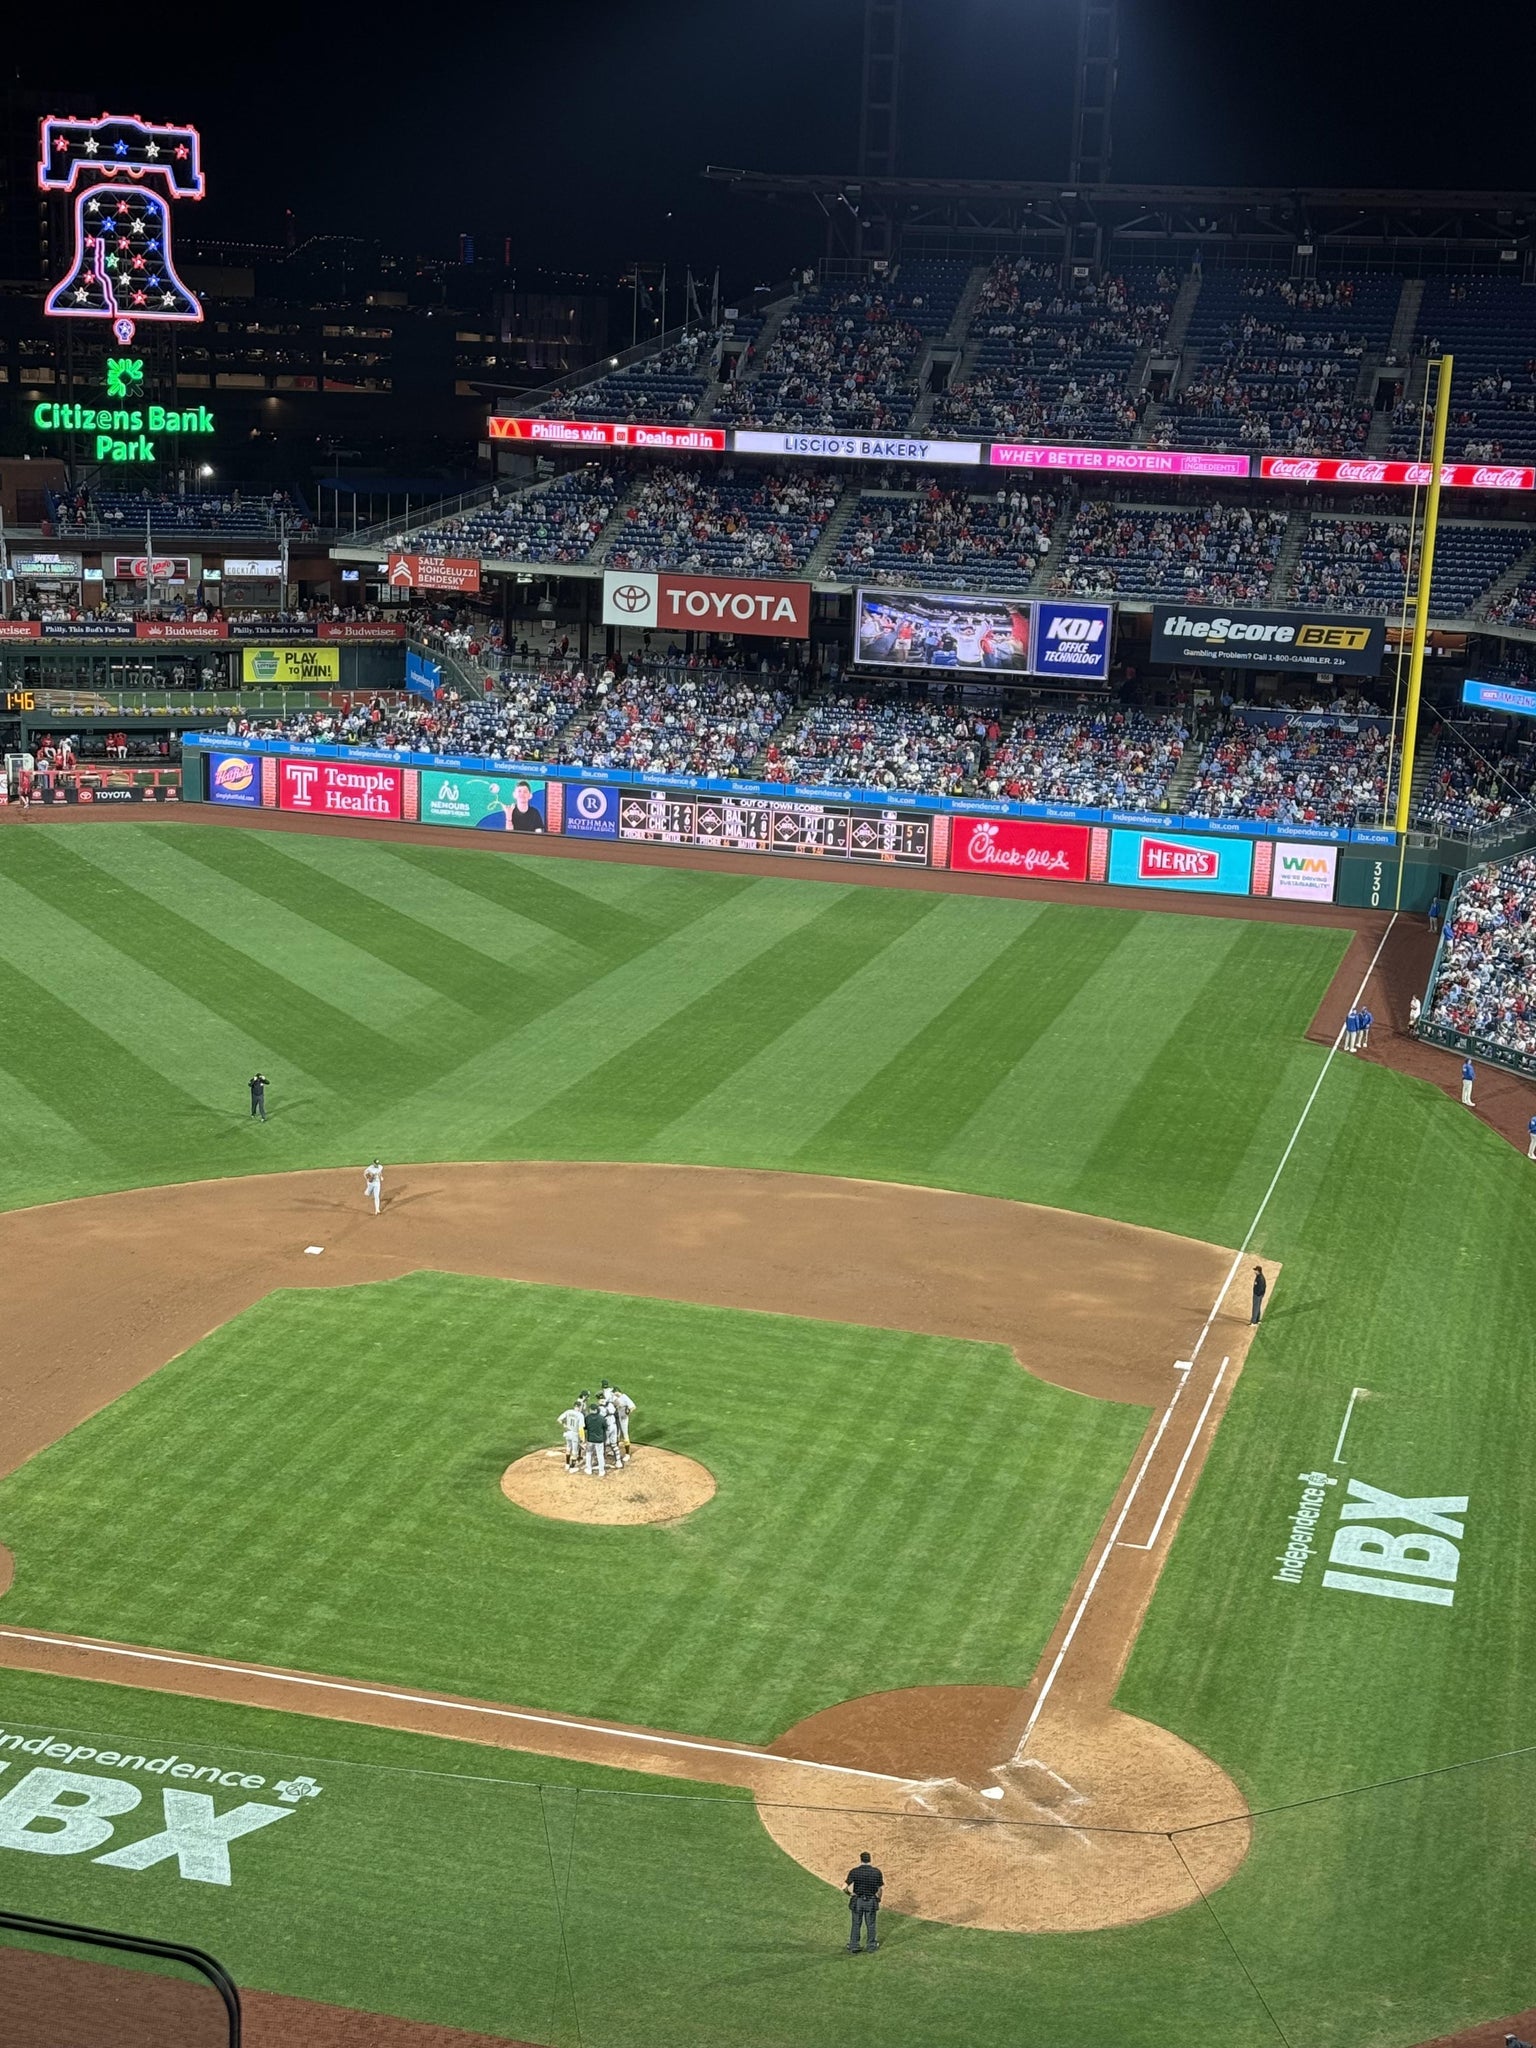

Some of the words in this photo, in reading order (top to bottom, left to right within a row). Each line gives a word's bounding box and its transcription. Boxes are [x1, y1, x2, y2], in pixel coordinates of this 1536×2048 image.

[34, 402, 143, 430] Citizens
[148, 406, 215, 432] Bank
[532, 424, 579, 440] Phillies
[582, 427, 606, 441] win
[636, 430, 674, 445] Deals
[676, 432, 698, 446] roll
[700, 434, 713, 447] in
[96, 435, 155, 461] Park
[785, 438, 855, 454] LISCIO'S
[862, 442, 929, 457] BAKERY
[1000, 450, 1042, 463] WHEY
[1048, 452, 1102, 466] BETTER
[1107, 455, 1172, 469] PROTEIN
[1185, 463, 1236, 472] INGREDIENTS
[418, 556, 445, 566] SALTZ
[418, 566, 477, 578] MONGELUZZI
[418, 574, 465, 585] BENDESKY
[666, 590, 798, 622] TOYOTA
[255, 626, 270, 634] This
[301, 626, 314, 634] You
[1046, 617, 1104, 642] KDI
[1163, 616, 1295, 643] theScore
[1302, 628, 1366, 646] BET
[1058, 641, 1090, 653] OFFICE
[285, 652, 317, 664] PLAY
[1044, 650, 1102, 664] TECHNOLOGY
[1184, 648, 1217, 658] Gambling
[1218, 650, 1252, 660] Problem?
[289, 666, 300, 674] TO
[302, 665, 331, 677] WIN!
[7, 692, 34, 710] 1:46
[198, 736, 242, 747] Independence
[348, 749, 393, 760] Independence
[494, 762, 539, 772] Independence
[286, 764, 318, 800] T
[324, 768, 394, 794] Temple
[642, 774, 688, 785] Independence
[96, 791, 132, 799] TOYOTA
[796, 787, 842, 798] Independence
[325, 790, 390, 814] Health
[586, 798, 598, 809] R
[740, 799, 756, 807] OUT
[757, 800, 768, 808] OF
[770, 802, 792, 810] TOWN
[794, 804, 824, 812] SCORES
[888, 795, 916, 804] ibx.com
[650, 804, 666, 816] CIN
[674, 806, 680, 818] 2
[952, 800, 1000, 812] Independence
[726, 810, 743, 822] BAL
[750, 812, 756, 824] 7
[1046, 808, 1076, 818] ibx.com
[1112, 813, 1163, 824] Independence
[568, 818, 616, 828] ROTHMAN
[649, 818, 666, 830] CHC
[684, 814, 690, 825] 6
[806, 817, 820, 830] PIT
[828, 818, 834, 831] 0
[726, 824, 743, 836] MIA
[884, 823, 896, 836] SD
[906, 826, 914, 838] 5
[1209, 821, 1240, 831] ibx.com
[1277, 826, 1329, 838] Independence
[806, 832, 818, 844] AZ
[827, 833, 834, 845] 0
[1358, 833, 1388, 842] ibx.com
[884, 838, 896, 850] SF
[967, 826, 1070, 870] Chick-fil-A
[1147, 848, 1210, 873] HERR'S
[1282, 856, 1328, 872] WM
[1272, 1487, 1326, 1584] Independence
[1322, 1478, 1469, 1606] IBX
[0, 1729, 266, 1789] ndependence
[0, 1760, 296, 1886] BX
